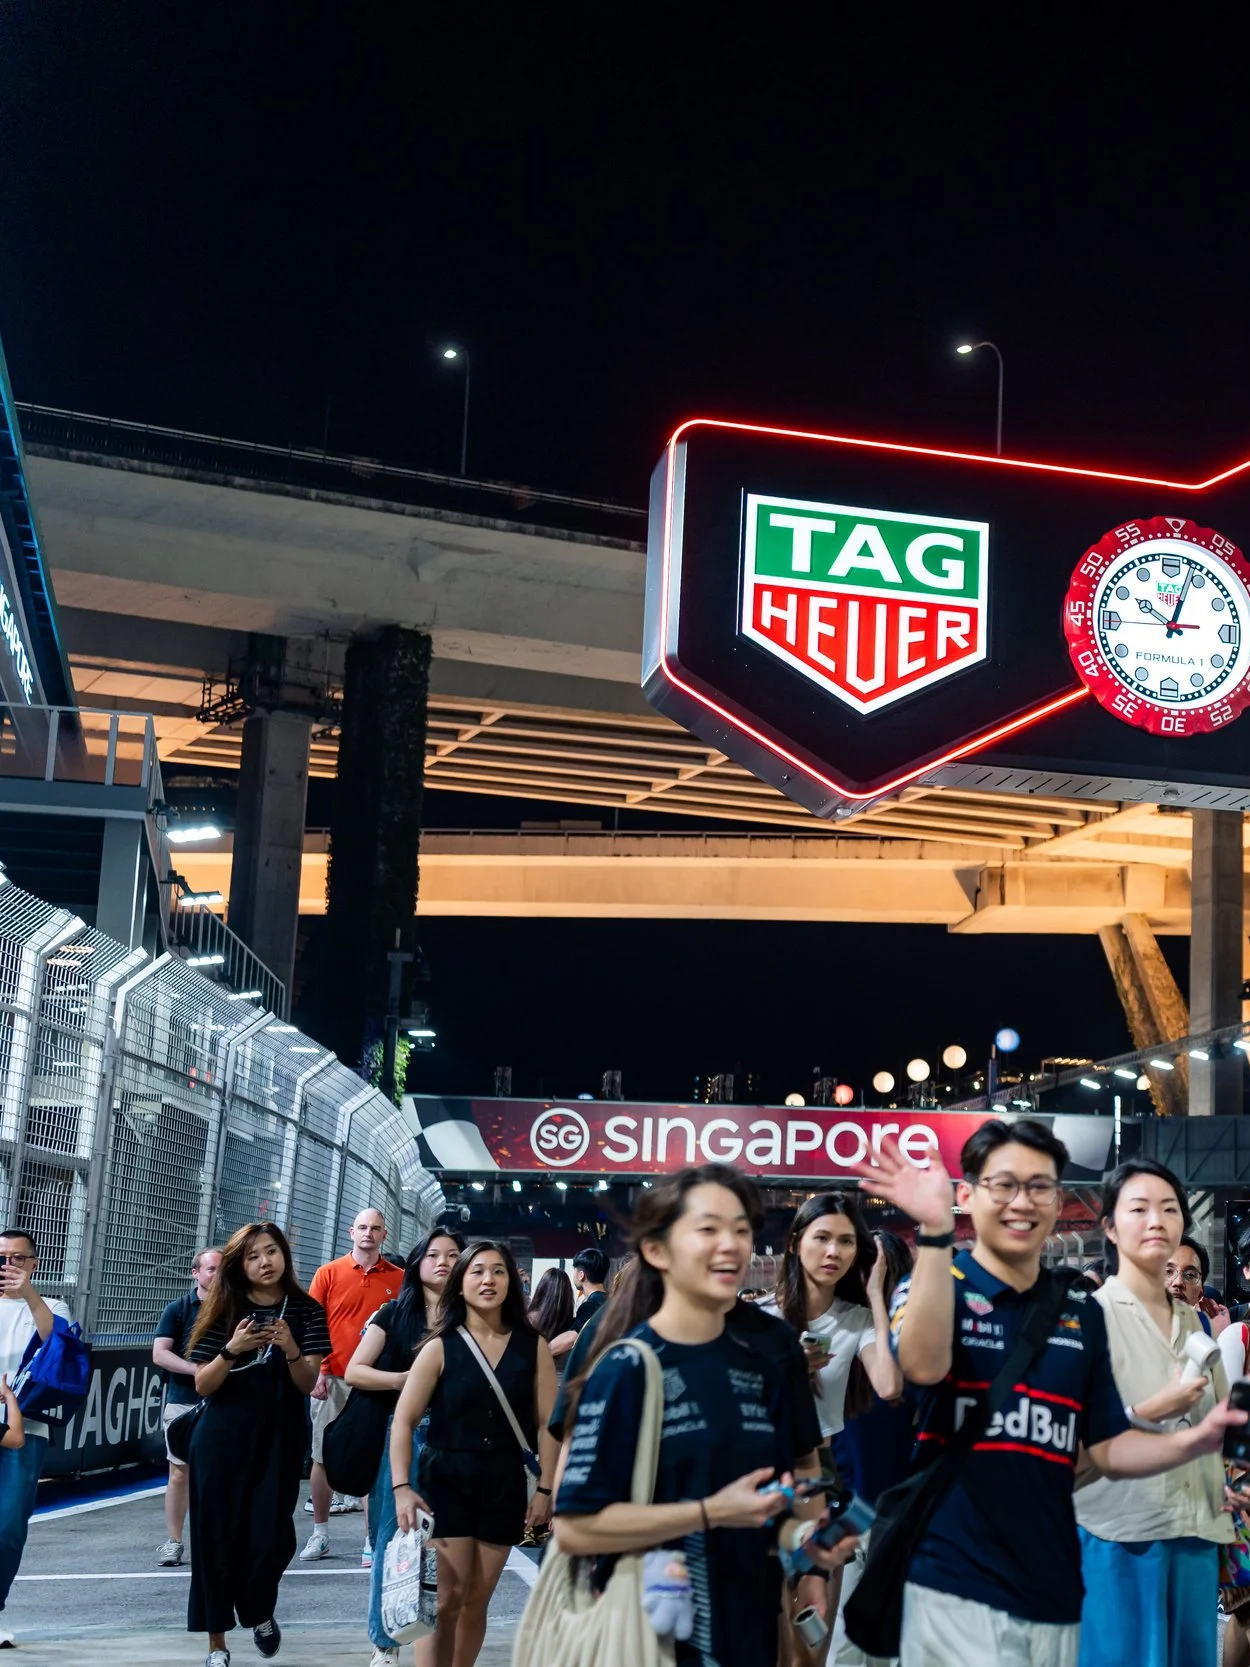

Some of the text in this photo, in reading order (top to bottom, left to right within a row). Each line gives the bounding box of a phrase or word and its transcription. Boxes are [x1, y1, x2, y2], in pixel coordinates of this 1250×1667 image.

[1115, 523, 1141, 543] 55
[1211, 533, 1236, 556] 05
[769, 512, 965, 590] TAG
[1080, 551, 1103, 578] 50
[1157, 592, 1181, 608] HEUE
[1159, 583, 1182, 594] TAG
[1070, 601, 1085, 626] 45
[761, 590, 971, 694] HEUER
[1077, 650, 1099, 677] 40
[1135, 651, 1205, 667] FORMULA 1
[1111, 694, 1139, 719] 35
[1210, 706, 1234, 727] 25
[1161, 716, 1187, 733] 30
[537, 1123, 584, 1151] SG
